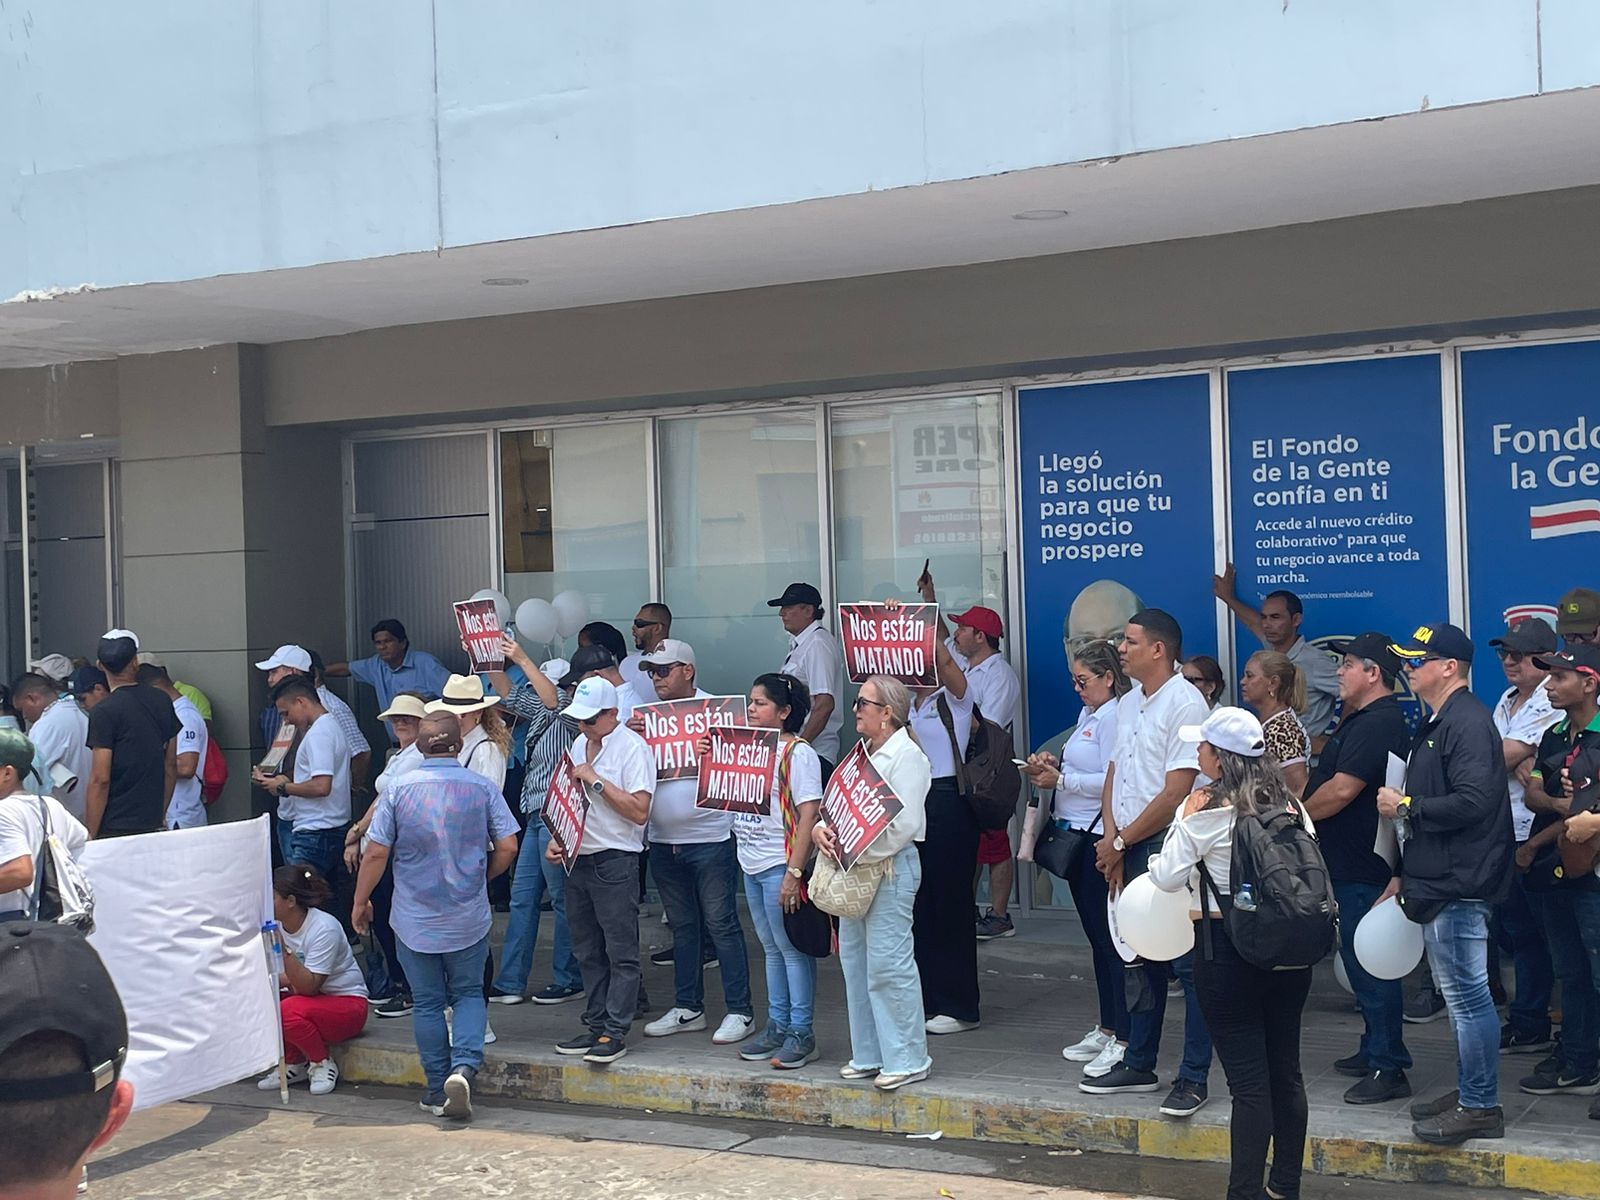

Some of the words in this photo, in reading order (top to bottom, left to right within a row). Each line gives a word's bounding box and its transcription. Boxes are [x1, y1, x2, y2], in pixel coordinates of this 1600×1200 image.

[1252, 439, 1273, 459] El
[1281, 434, 1359, 457] Fondo
[1039, 450, 1103, 474] Llegó
[1252, 463, 1282, 483] de
[1289, 461, 1310, 480] la
[1318, 458, 1391, 479] Gente
[1040, 476, 1058, 494] la
[1066, 470, 1163, 493] solución
[1511, 462, 1538, 490] la
[1040, 500, 1090, 520] para
[1097, 497, 1140, 517] que
[1147, 493, 1172, 511] tu
[1253, 484, 1326, 507] confía
[1334, 485, 1363, 502] en
[1371, 481, 1388, 500] ti
[1041, 517, 1133, 540] negocio
[1255, 517, 1302, 532] Accede
[1305, 516, 1317, 529] al
[1320, 516, 1361, 529] nuevo
[1364, 512, 1413, 527] crédito
[1041, 542, 1144, 564] prospere
[1347, 534, 1378, 549] para
[1380, 533, 1407, 547] que
[1256, 555, 1270, 567] tu
[1273, 552, 1325, 569] negocio
[1327, 552, 1374, 564] avance
[1377, 552, 1385, 563] a
[1388, 548, 1421, 562] toda
[1257, 571, 1309, 584] marcha.
[1329, 590, 1374, 599] reembolsable
[462, 609, 484, 634] Nos
[849, 612, 877, 641] Nos
[881, 614, 925, 642] están
[853, 646, 925, 677] MATANDO
[185, 730, 196, 740] 10
[645, 711, 678, 739] Nos
[684, 706, 734, 735] están
[649, 740, 698, 771] MATA
[711, 734, 736, 766] Nos
[737, 739, 770, 768] están
[556, 760, 571, 799] Nos
[707, 770, 765, 805] MATANDO
[840, 752, 860, 790] Nos
[851, 779, 886, 827] están
[546, 790, 579, 859] MATANDO
[825, 781, 865, 854] MATANDO
